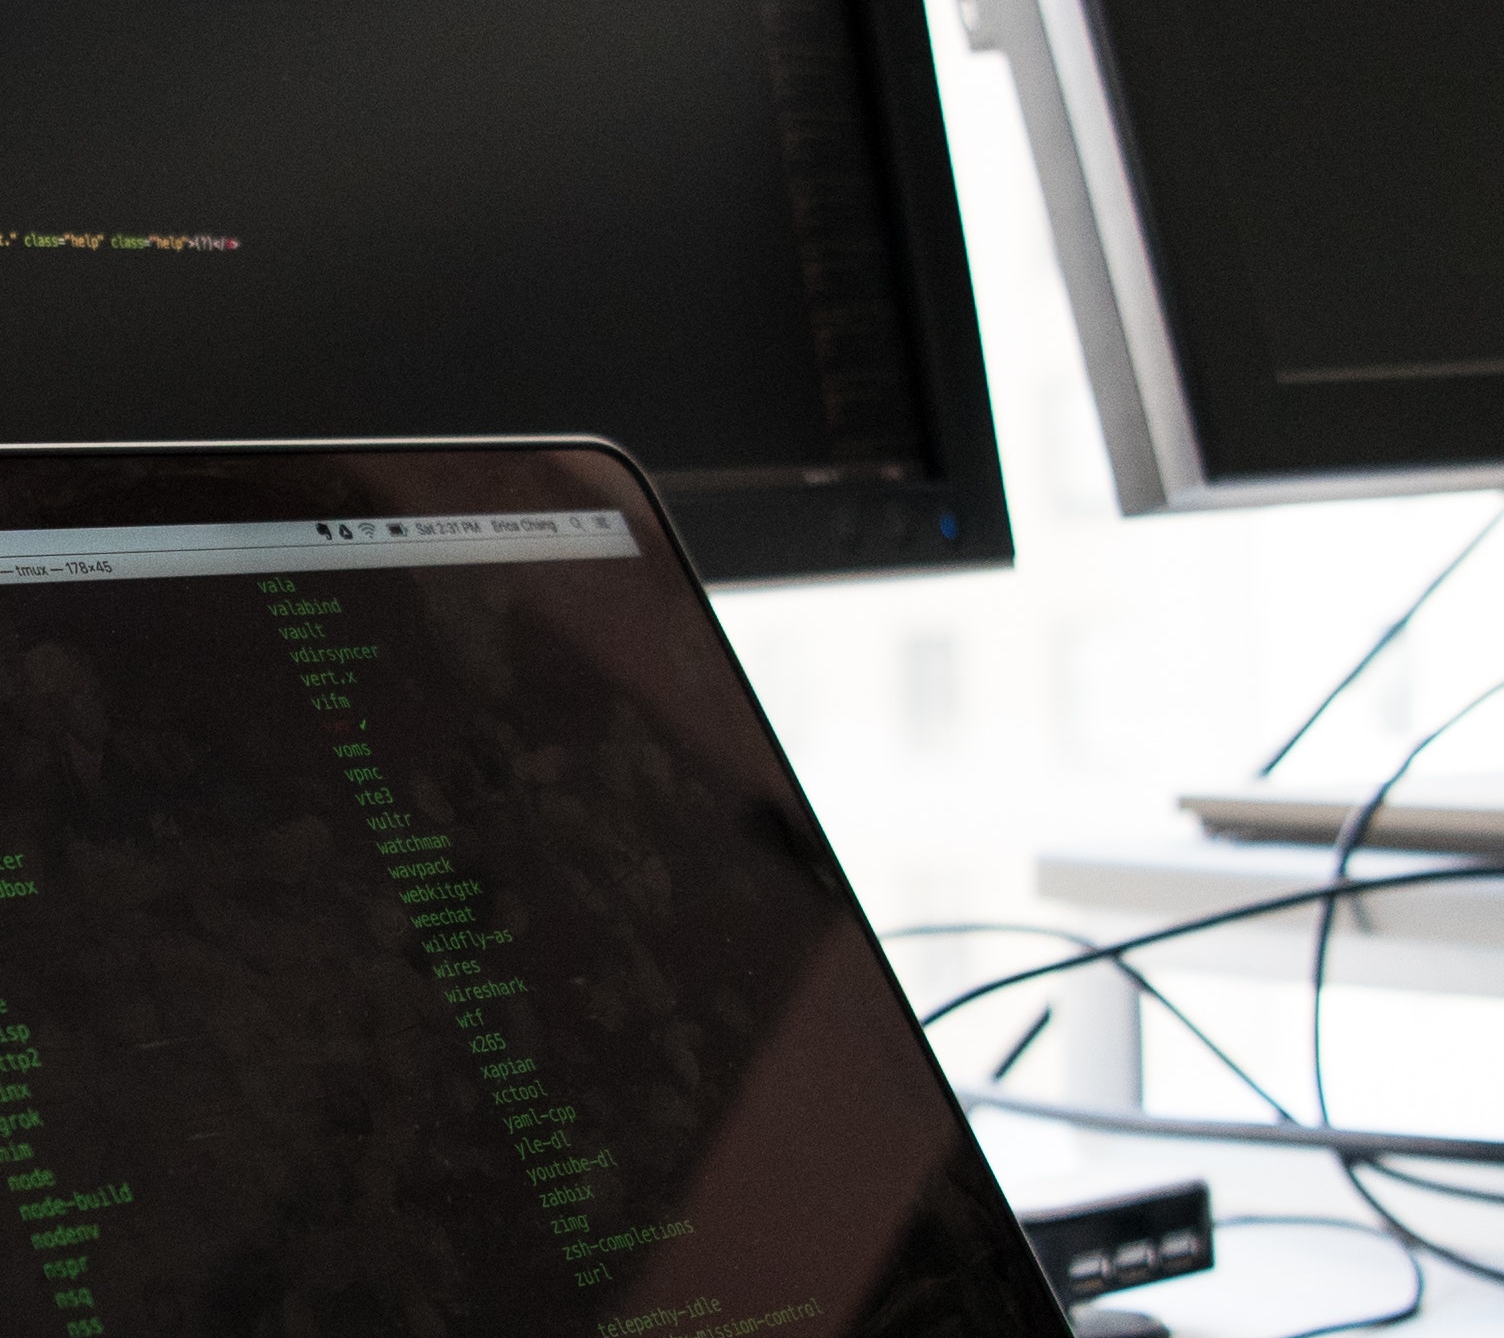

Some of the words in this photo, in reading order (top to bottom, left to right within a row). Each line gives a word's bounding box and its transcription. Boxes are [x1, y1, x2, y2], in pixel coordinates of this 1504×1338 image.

[16, 565, 49, 578] tmux
[256, 577, 296, 593] vala
[267, 598, 341, 616] valabind
[277, 622, 326, 640] vault
[288, 646, 380, 664] vdirsyncer
[299, 669, 356, 687] vert.x
[309, 693, 349, 711] vifm
[331, 744, 371, 758] voms
[342, 767, 382, 786] vpnc
[353, 787, 393, 806] vte3
[364, 811, 413, 831] vultr
[375, 834, 450, 855] watchman
[387, 856, 453, 880] wavpack
[398, 878, 481, 904] webkitgtk
[409, 905, 475, 929] weechat
[420, 930, 512, 954] wildfly-as
[432, 960, 480, 979] wires
[443, 976, 526, 1004] wireshark
[455, 1008, 486, 1029] wtf
[466, 1032, 506, 1054] x265
[478, 1057, 535, 1081] xapian
[489, 1079, 546, 1105] xctool
[501, 1106, 578, 1135] yaml-cpp
[513, 1130, 570, 1161] yle-dl
[6, 1166, 55, 1192] node
[525, 1149, 616, 1187] youtube-dl
[18, 1181, 132, 1221] node-build
[536, 1183, 594, 1208] zabbix
[548, 1214, 590, 1234] zimg
[29, 1223, 101, 1250] nodenv
[560, 1220, 694, 1261] zsh-completions
[572, 1262, 612, 1287] zurl
